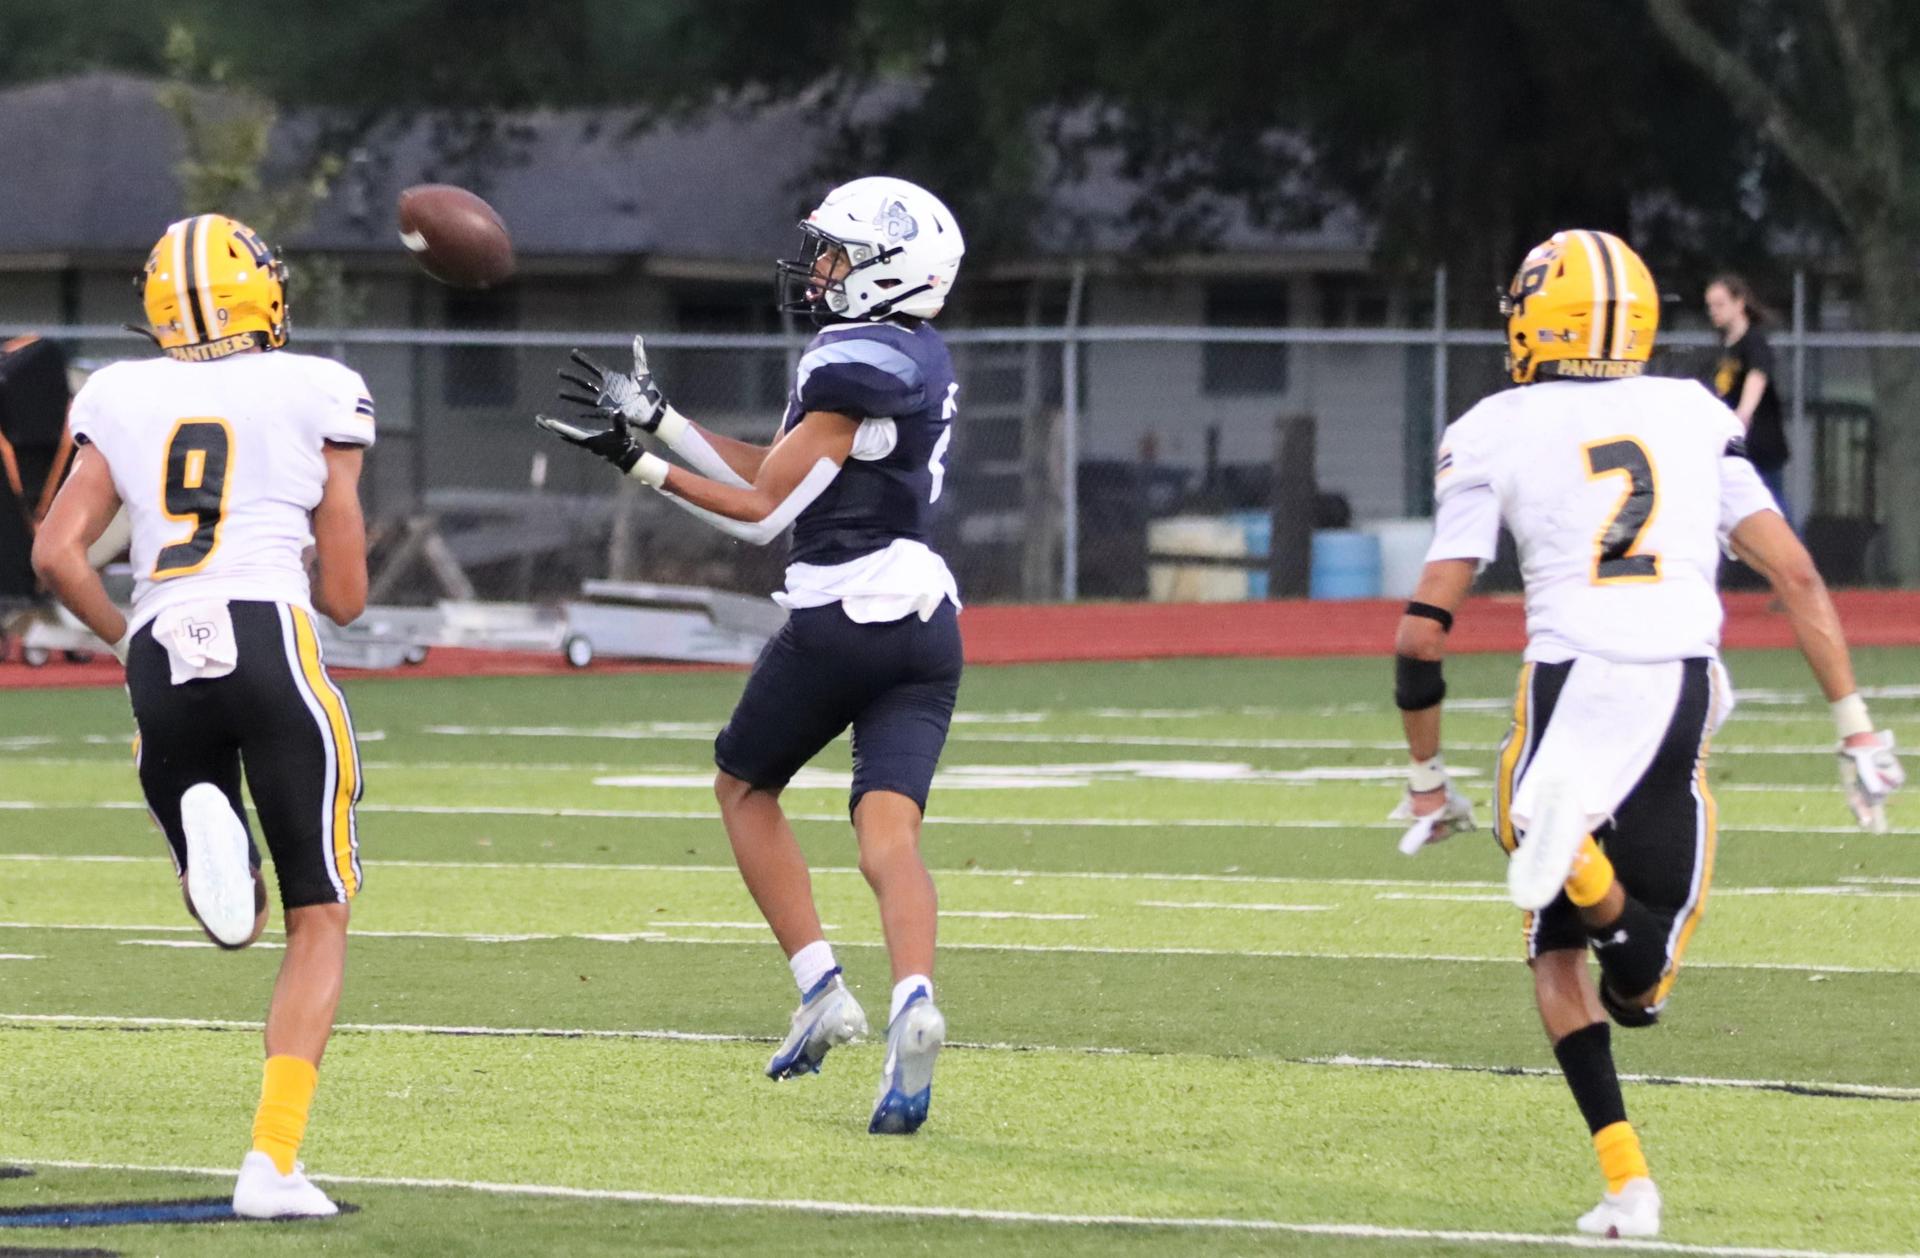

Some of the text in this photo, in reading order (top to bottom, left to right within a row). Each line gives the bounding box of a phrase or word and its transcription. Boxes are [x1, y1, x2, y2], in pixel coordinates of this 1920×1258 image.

[217, 308, 228, 327] 9
[168, 333, 255, 362] PANTHERS
[1558, 360, 1643, 378] PANTHERS
[150, 416, 236, 581] 9
[1580, 434, 1664, 586] 2
[188, 624, 211, 645] LP
